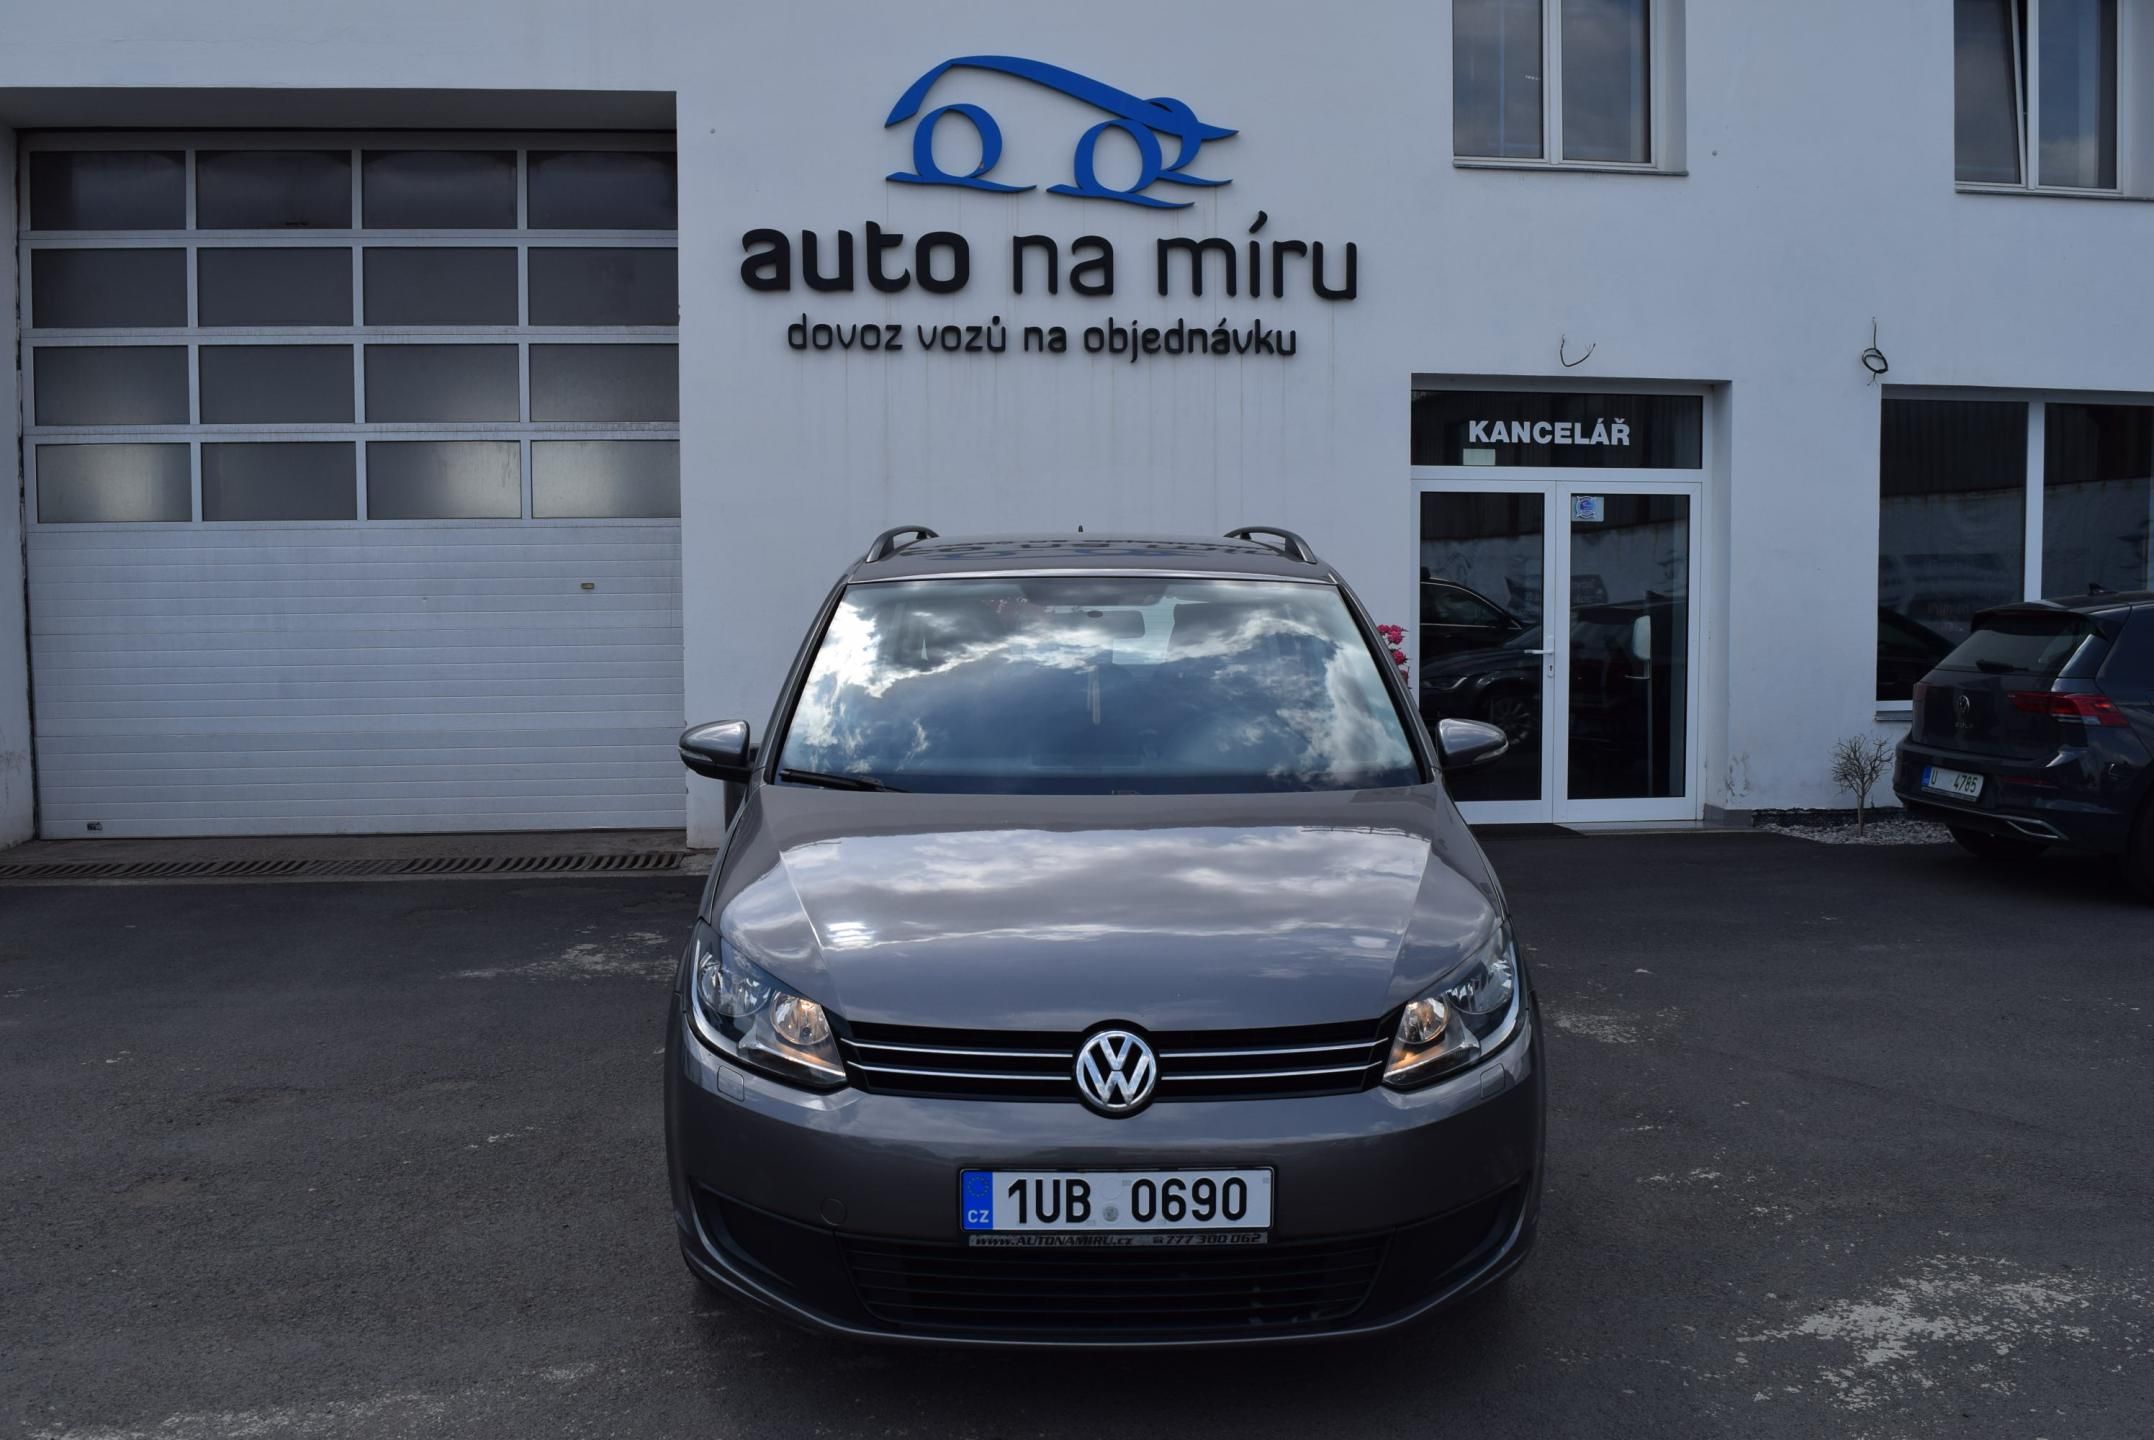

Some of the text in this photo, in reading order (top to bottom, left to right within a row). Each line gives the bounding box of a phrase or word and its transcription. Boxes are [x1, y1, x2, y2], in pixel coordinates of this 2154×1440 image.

[740, 210, 1358, 300] auto na míru
[787, 313, 1297, 363] dovoz vozů na objednávku
[1469, 418, 1630, 446] KANCELÁŘ
[967, 1209, 989, 1224] CZ
[1008, 1177, 1247, 1224] 1UB 0690
[1166, 1234, 1195, 1245] 777
